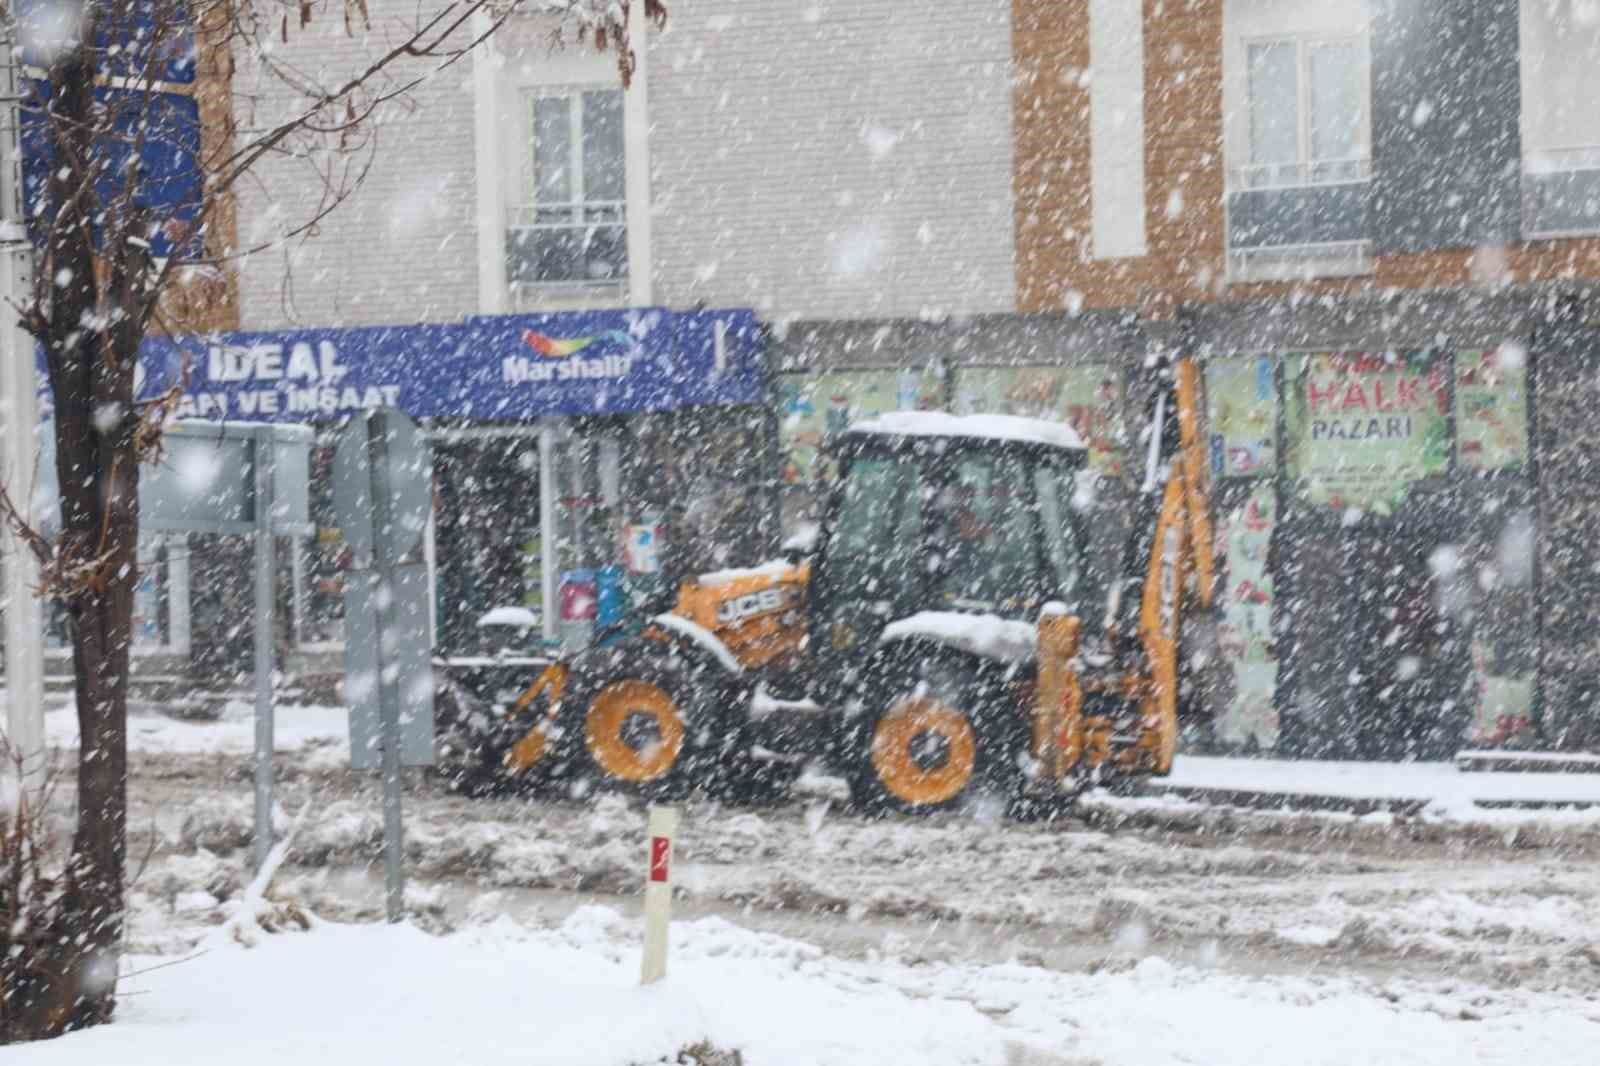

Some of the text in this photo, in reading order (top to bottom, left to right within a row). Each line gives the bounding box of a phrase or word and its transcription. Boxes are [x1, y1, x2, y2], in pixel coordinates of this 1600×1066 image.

[502, 355, 630, 384] Marshall
[173, 390, 229, 417] API
[239, 391, 280, 413] VE
[1308, 376, 1424, 412] HALK
[1312, 416, 1412, 439] PAZARI
[718, 588, 786, 621] JCB
